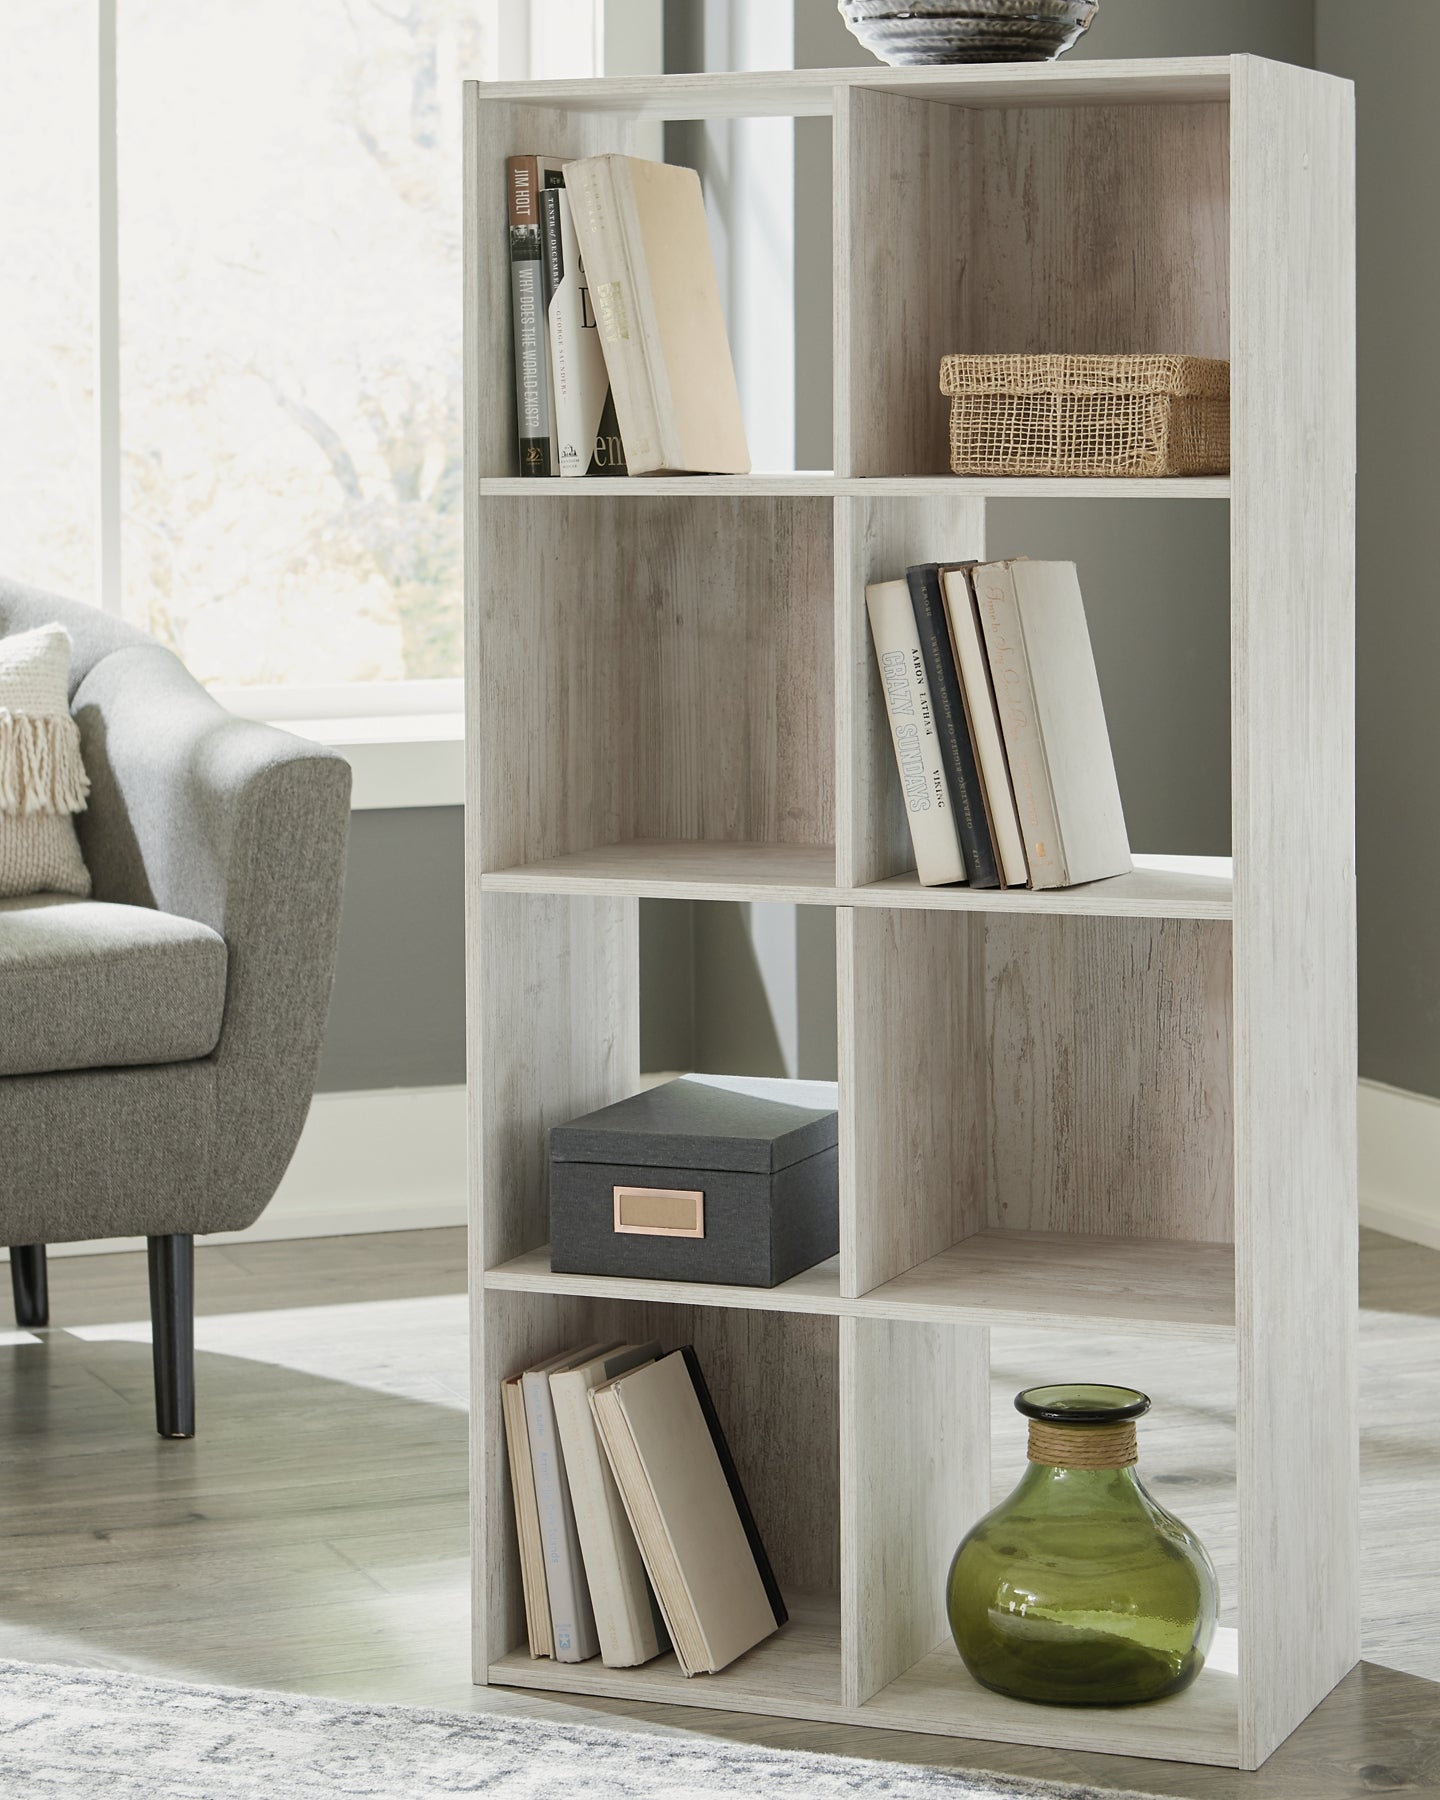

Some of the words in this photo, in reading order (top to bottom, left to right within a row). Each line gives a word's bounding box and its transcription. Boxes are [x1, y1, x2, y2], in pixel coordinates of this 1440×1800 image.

[514, 169, 530, 188] JIM
[515, 190, 531, 216] HOLT
[548, 197, 556, 227] TENTH
[550, 228, 556, 238] of
[518, 268, 534, 293] WHY
[520, 296, 535, 325] DOES
[556, 310, 564, 345] GEORGE
[521, 326, 536, 347] THE
[522, 349, 538, 388] WORLD
[559, 349, 567, 395] SAUNDERS
[524, 391, 540, 428] EXIST?
[931, 634, 945, 682] CARRIERS
[882, 651, 914, 716] CRAZY
[911, 648, 925, 685] AARON
[920, 692, 933, 736] LATHAM
[940, 685, 952, 720] MOTOR
[946, 723, 955, 736] OF
[895, 723, 931, 812] SUNDAYS
[950, 738, 962, 772] RIGHTS
[932, 769, 945, 808] VIKING
[958, 776, 973, 829] OPERATING
